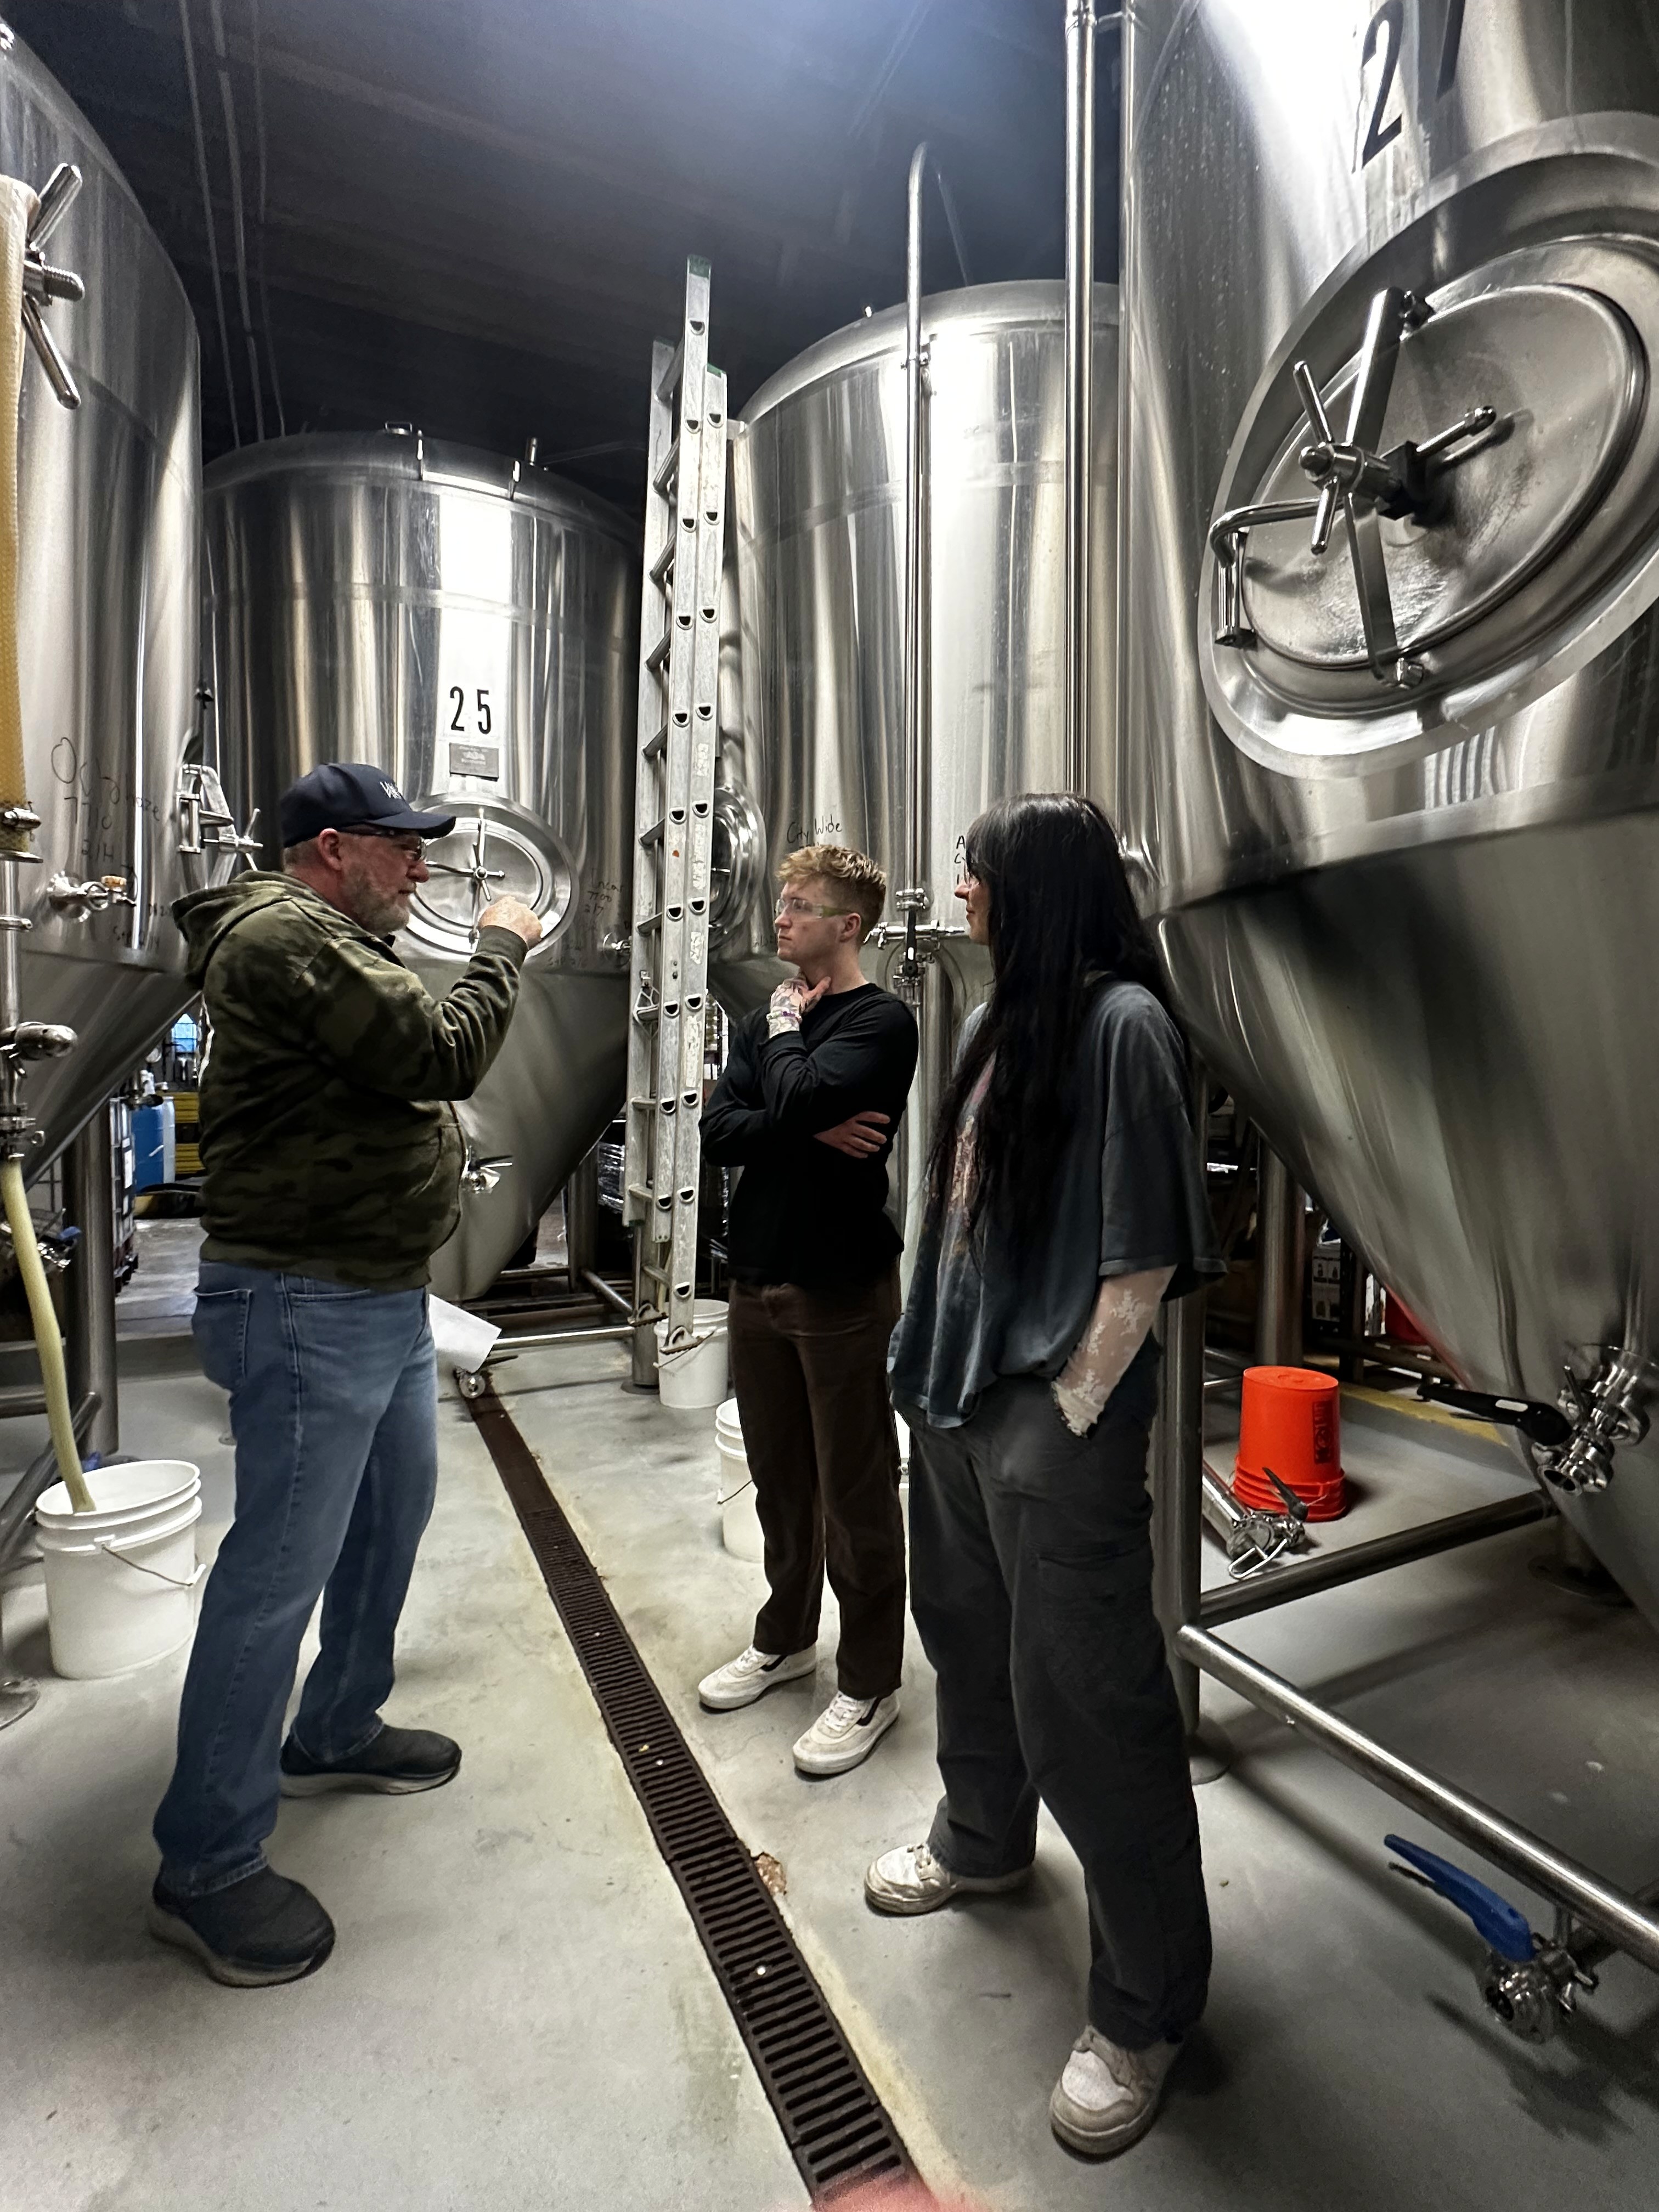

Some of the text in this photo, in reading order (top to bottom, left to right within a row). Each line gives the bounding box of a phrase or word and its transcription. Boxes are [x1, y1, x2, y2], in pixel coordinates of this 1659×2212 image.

[450, 686, 492, 735] 25
[787, 814, 843, 844] City Wide
